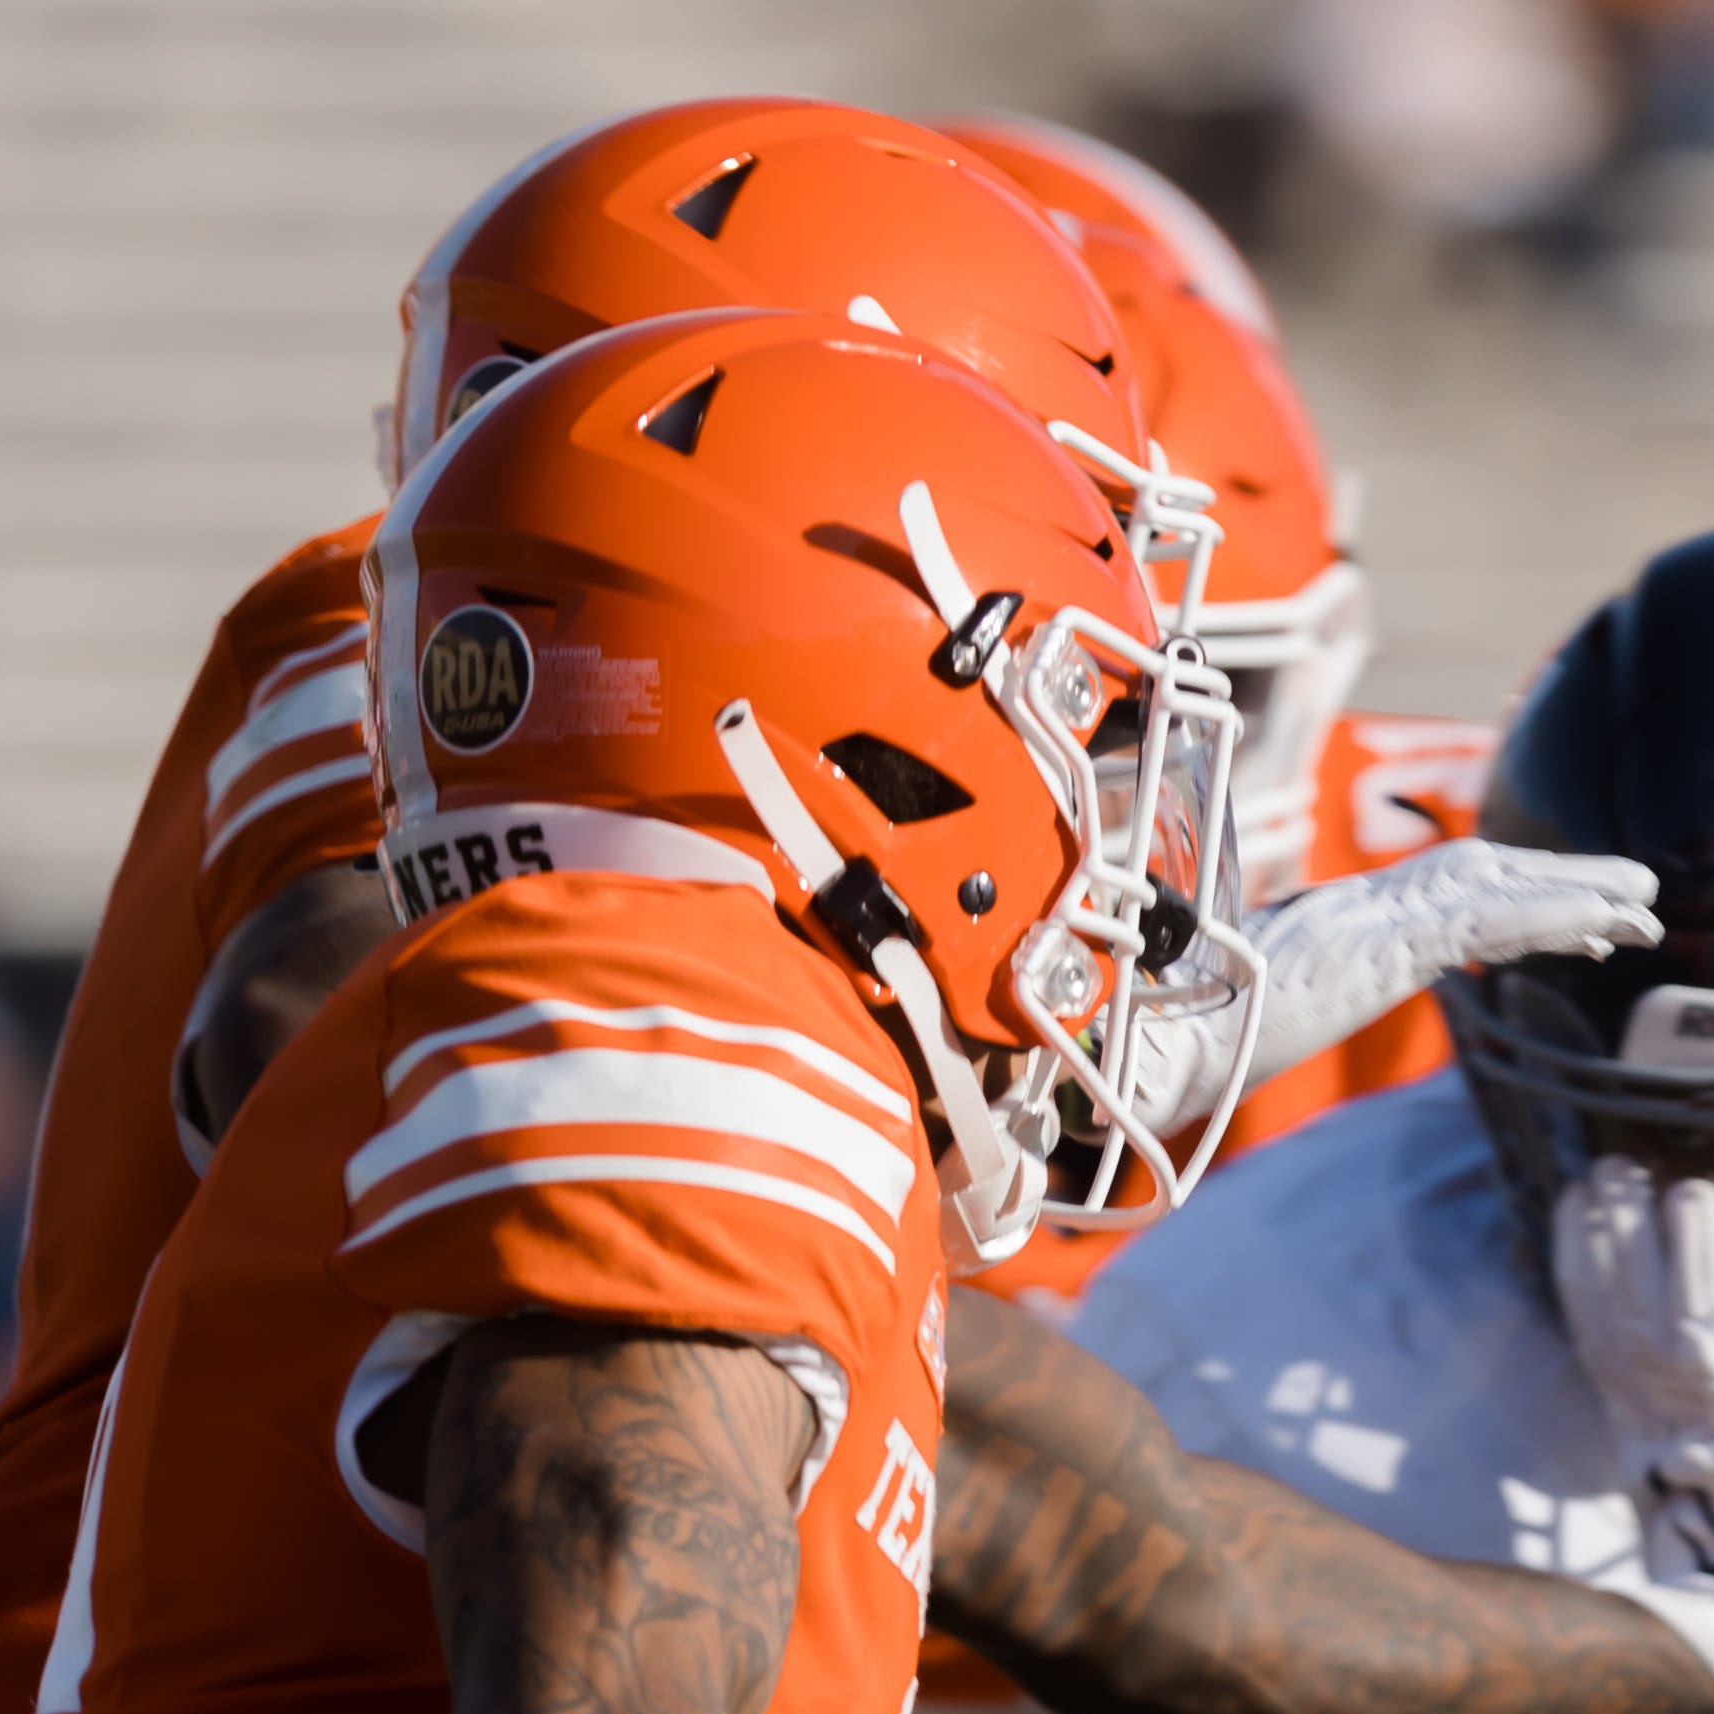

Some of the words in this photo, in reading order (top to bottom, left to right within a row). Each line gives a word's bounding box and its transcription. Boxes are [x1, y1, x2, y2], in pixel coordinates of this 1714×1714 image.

[431, 634, 519, 714] RDA
[536, 645, 602, 660] WARNING
[392, 822, 554, 922] NERS
